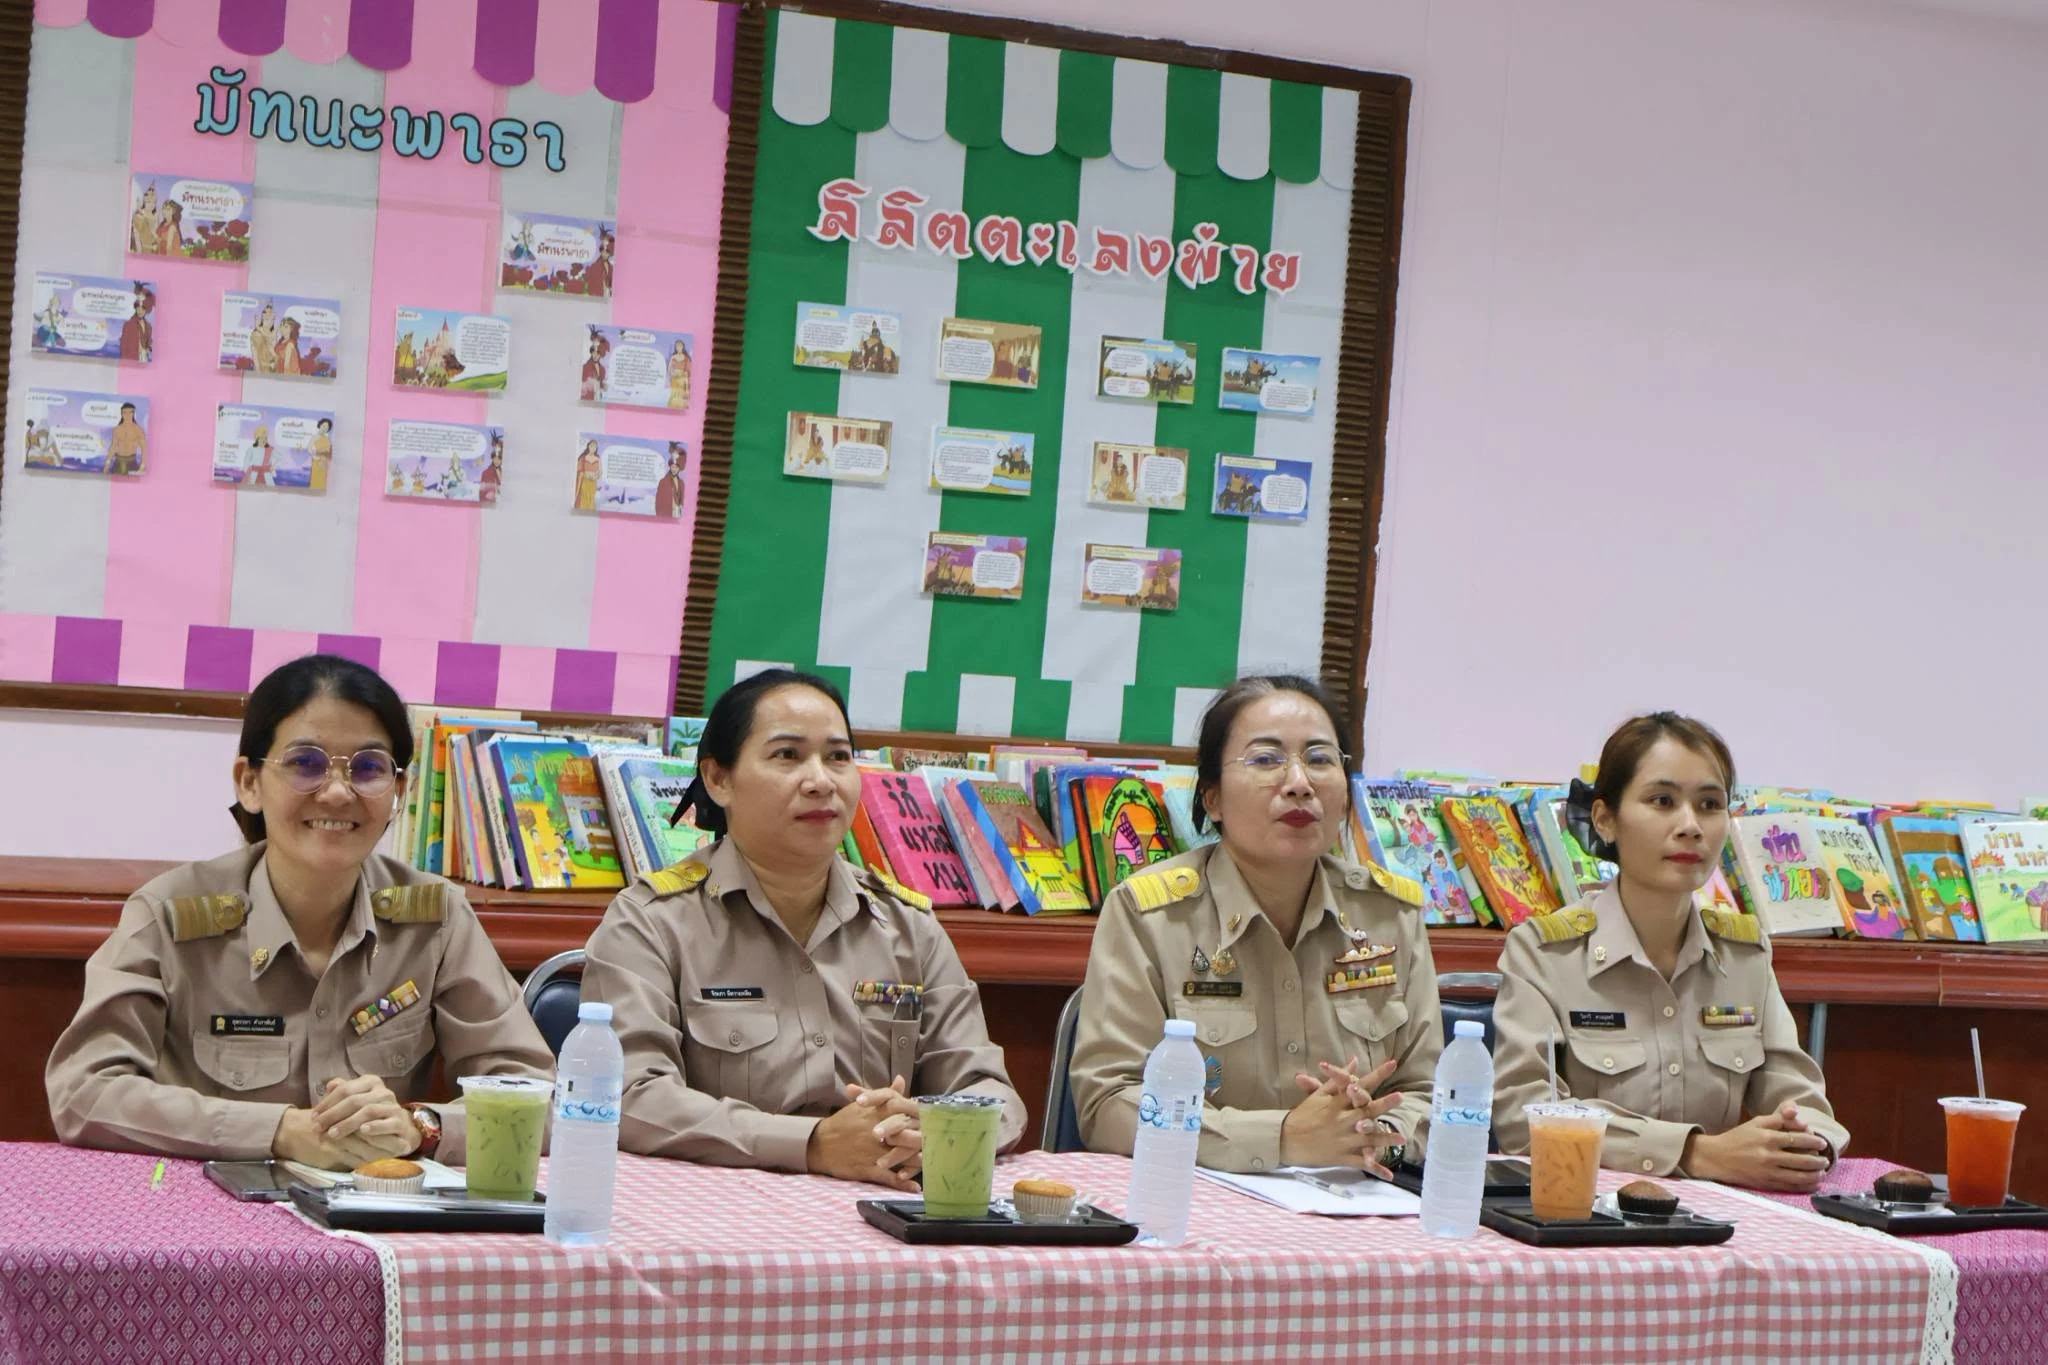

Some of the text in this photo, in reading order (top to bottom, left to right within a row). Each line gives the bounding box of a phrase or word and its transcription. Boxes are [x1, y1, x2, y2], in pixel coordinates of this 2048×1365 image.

[194, 65, 566, 172] มัทนะพาธา
[808, 178, 1301, 295] ลิลิตตะเลงพ่าย
